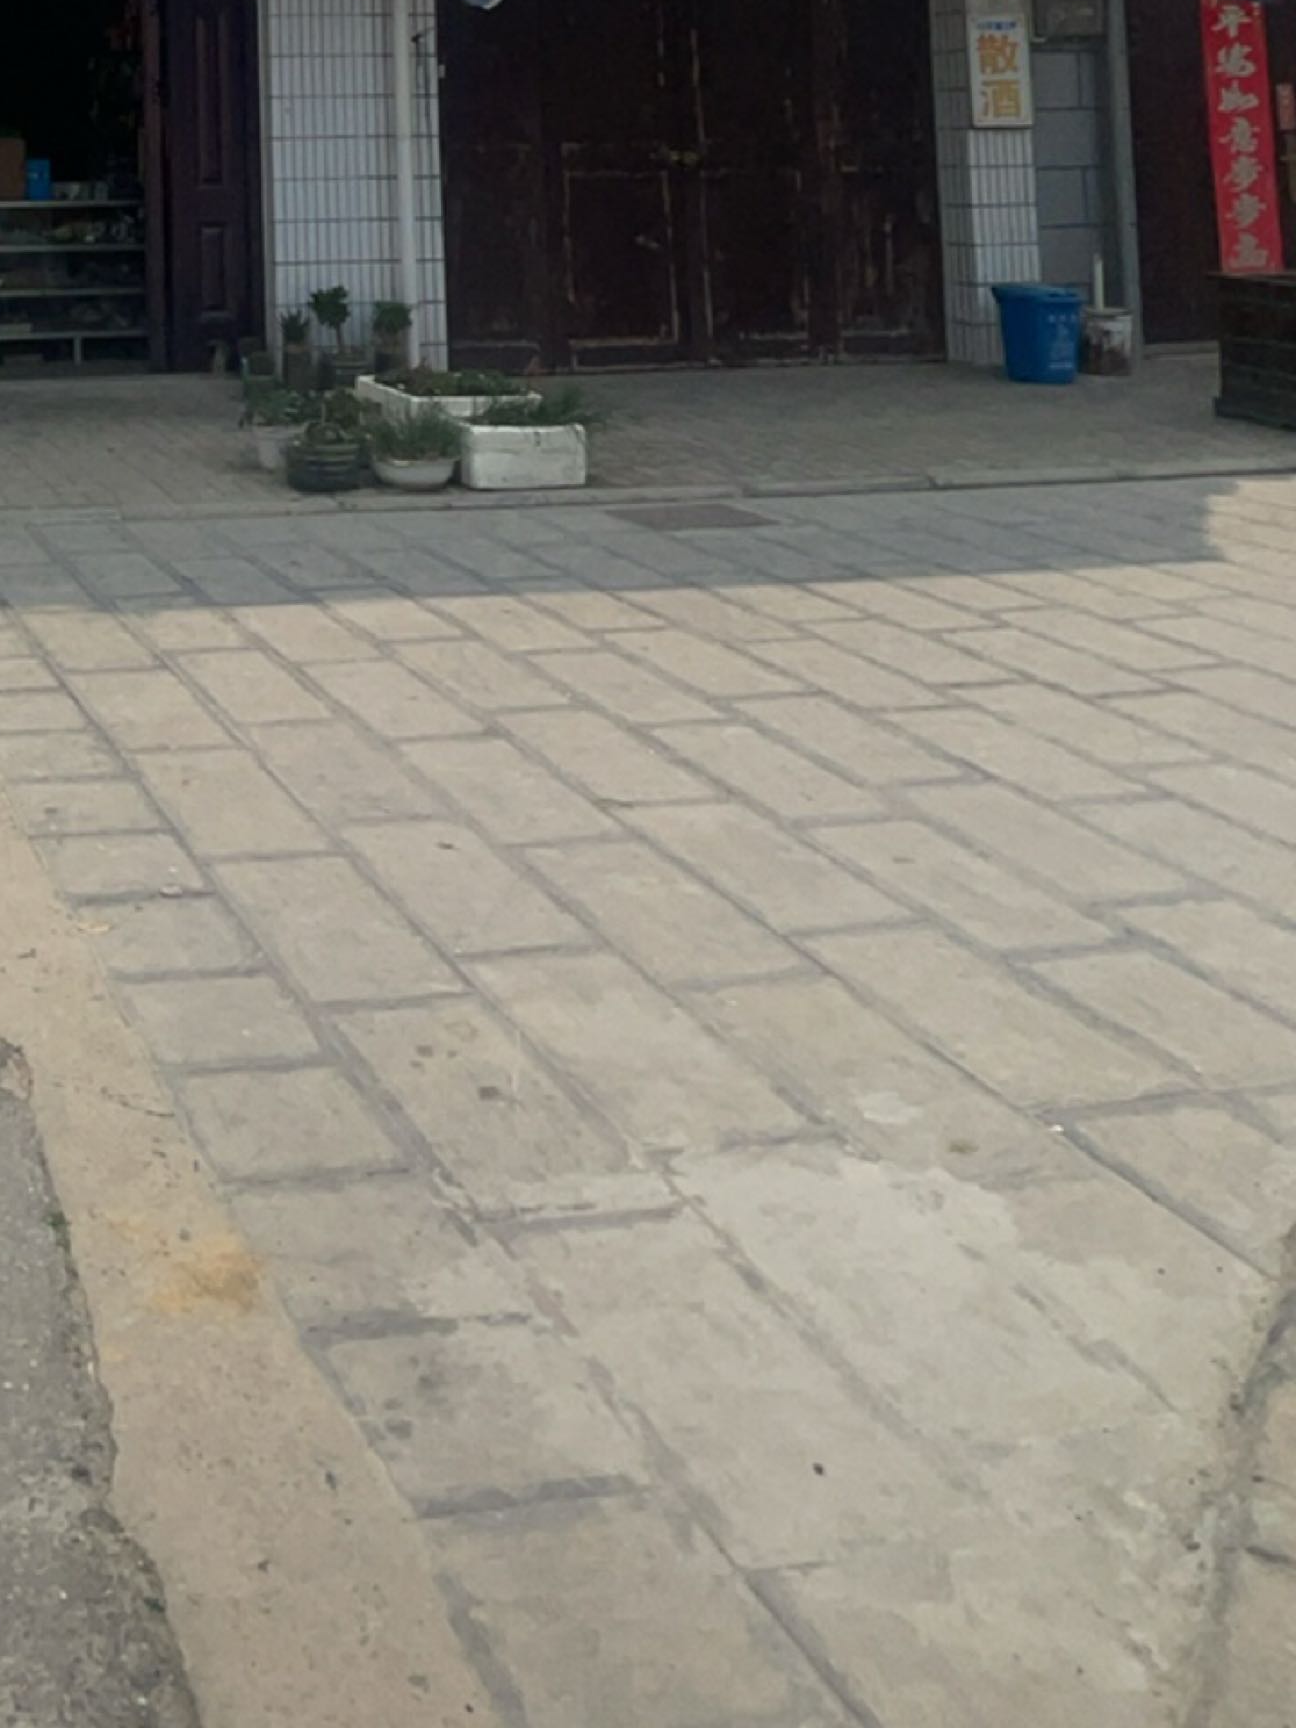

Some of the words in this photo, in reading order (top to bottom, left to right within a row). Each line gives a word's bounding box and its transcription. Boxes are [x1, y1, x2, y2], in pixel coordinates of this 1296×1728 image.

[975, 33, 1021, 118] 散酒
[1210, 4, 1269, 270] 平安如意步步高
